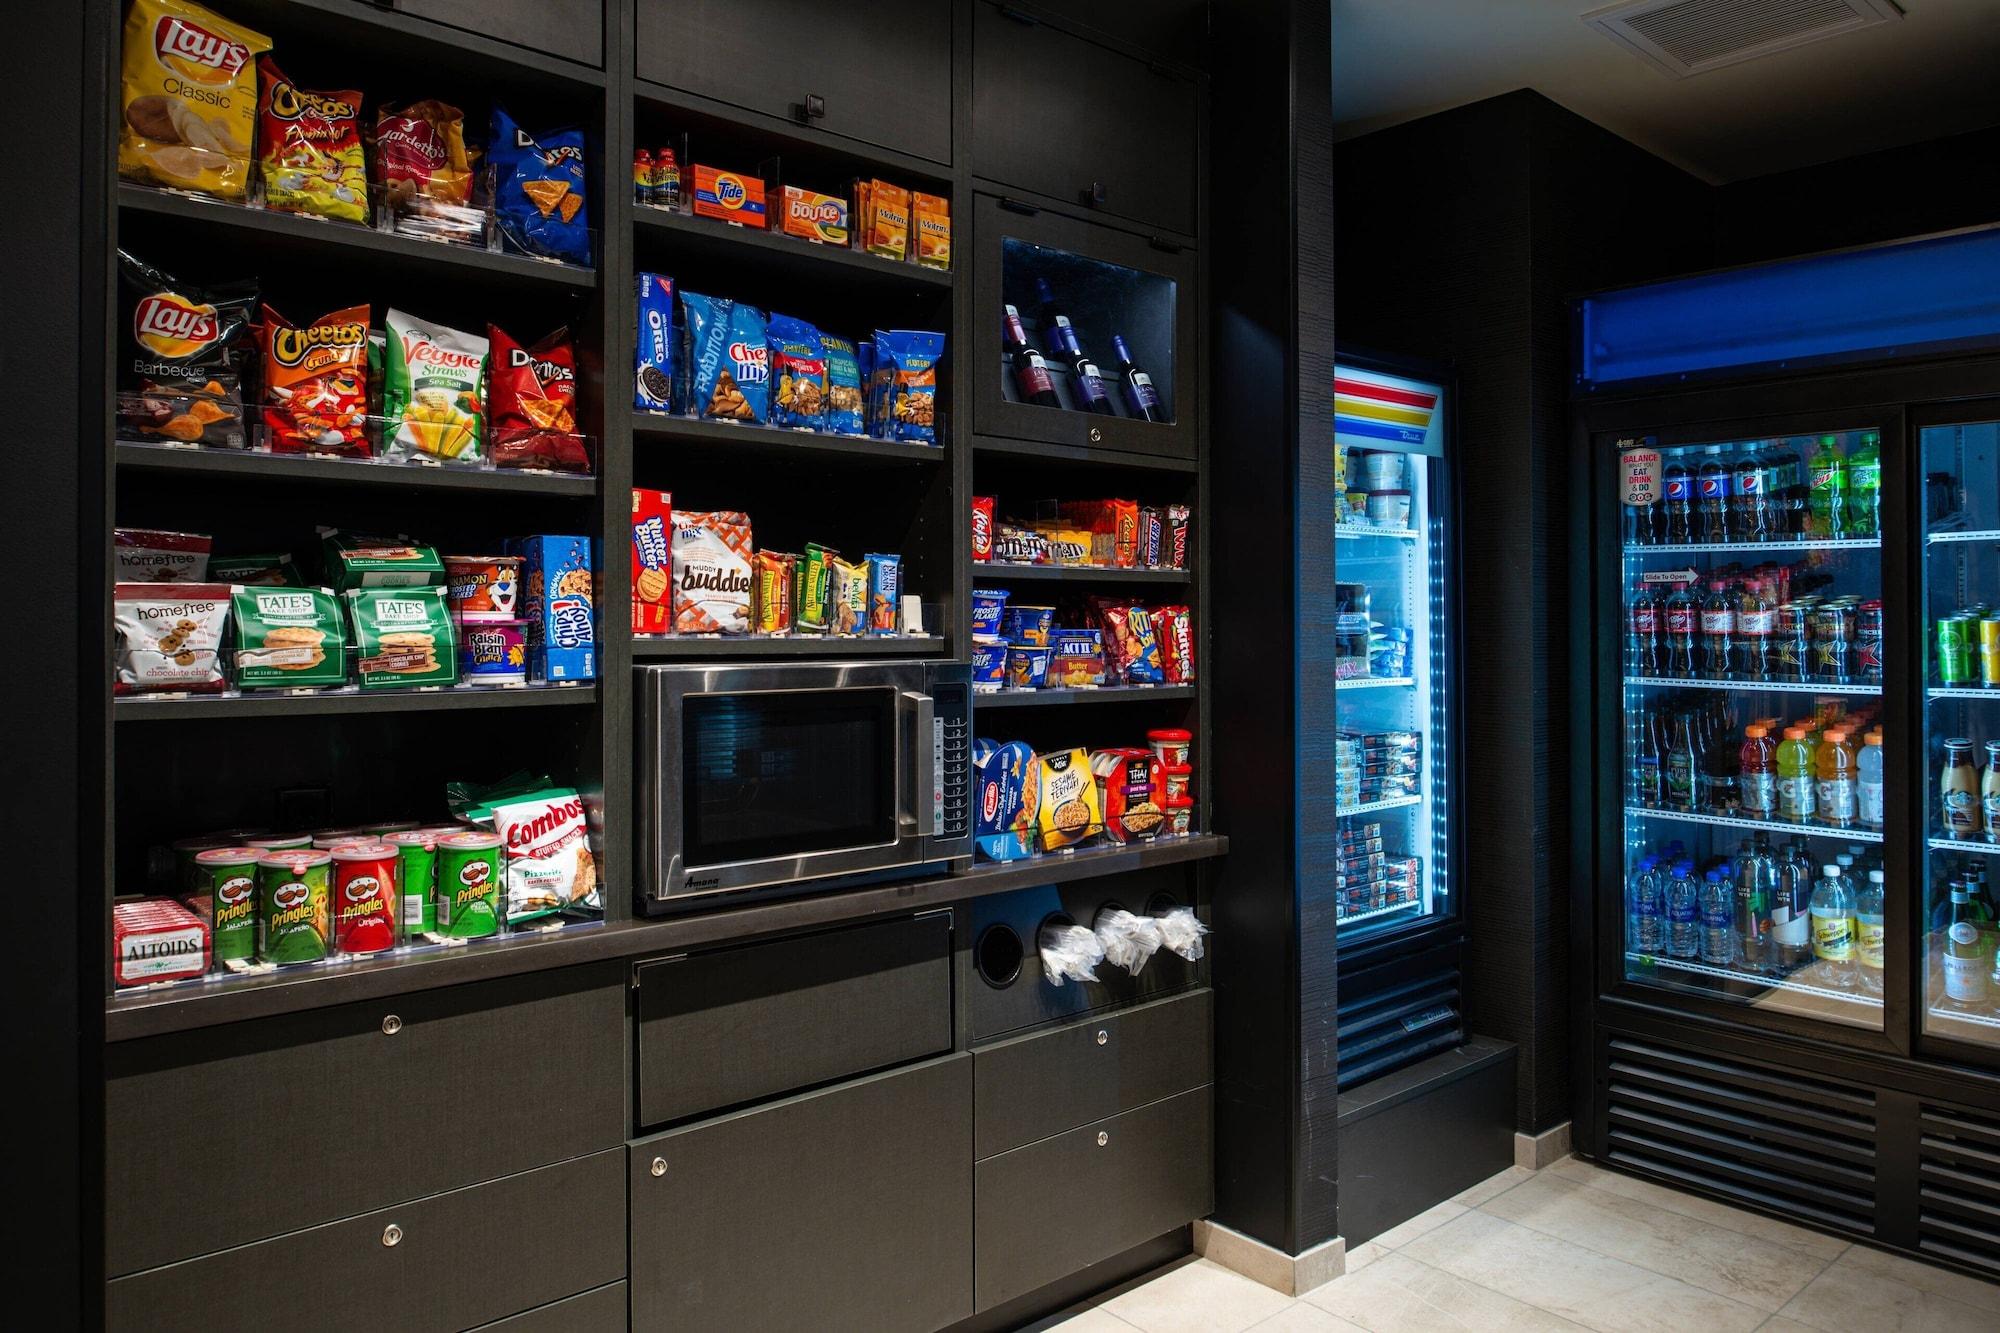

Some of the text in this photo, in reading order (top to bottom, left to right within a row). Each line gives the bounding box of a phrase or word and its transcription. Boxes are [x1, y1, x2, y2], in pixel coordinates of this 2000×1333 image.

[161, 19, 248, 68] Lay's
[164, 78, 232, 109] Classic
[718, 181, 743, 200] Tide
[791, 201, 840, 223] bounce
[879, 209, 905, 224] Motrin
[922, 220, 948, 233] Motrin
[140, 300, 213, 339] Lay's
[276, 324, 364, 362] Cheetos
[648, 310, 664, 363] OREO
[303, 348, 351, 370] Crunch
[402, 336, 482, 369] Veggie
[134, 360, 206, 377] Barbecue
[421, 364, 468, 378] Straws
[428, 378, 462, 389] Sea Salt
[1623, 454, 1658, 464] BALANCE
[1628, 476, 1652, 484] DRINK
[635, 524, 658, 570] Butter
[647, 517, 667, 565] Nutter
[1149, 519, 1161, 565] SNICKERS
[120, 554, 196, 567] homefree
[550, 569, 565, 600] ORIGINAL
[259, 595, 313, 609] TATE'S
[378, 602, 424, 614] TATE'S
[137, 601, 215, 621] homefree
[558, 610, 578, 648] Chips
[470, 634, 505, 646] Raisin
[473, 644, 503, 656] Bran
[1063, 642, 1090, 654] ACT II
[475, 653, 503, 665] Crunch
[1069, 662, 1088, 670] Butter
[146, 667, 210, 677] chocolate chip
[956, 729, 961, 737] 2
[956, 752, 961, 760] 4
[956, 764, 961, 772] 5
[1129, 769, 1147, 780] THAI
[1051, 770, 1075, 789] SESAME
[956, 787, 961, 795] 7
[1051, 778, 1079, 800] TERIYAKI
[956, 799, 961, 807] 8
[508, 799, 586, 849] Combos
[535, 843, 560, 857] STUFFED
[685, 876, 720, 888] Amana
[456, 881, 494, 907] Pringles
[272, 904, 315, 932] Pringles
[343, 899, 384, 925] Pringles
[358, 917, 385, 927] Original
[128, 939, 198, 961] ALTOIDS
